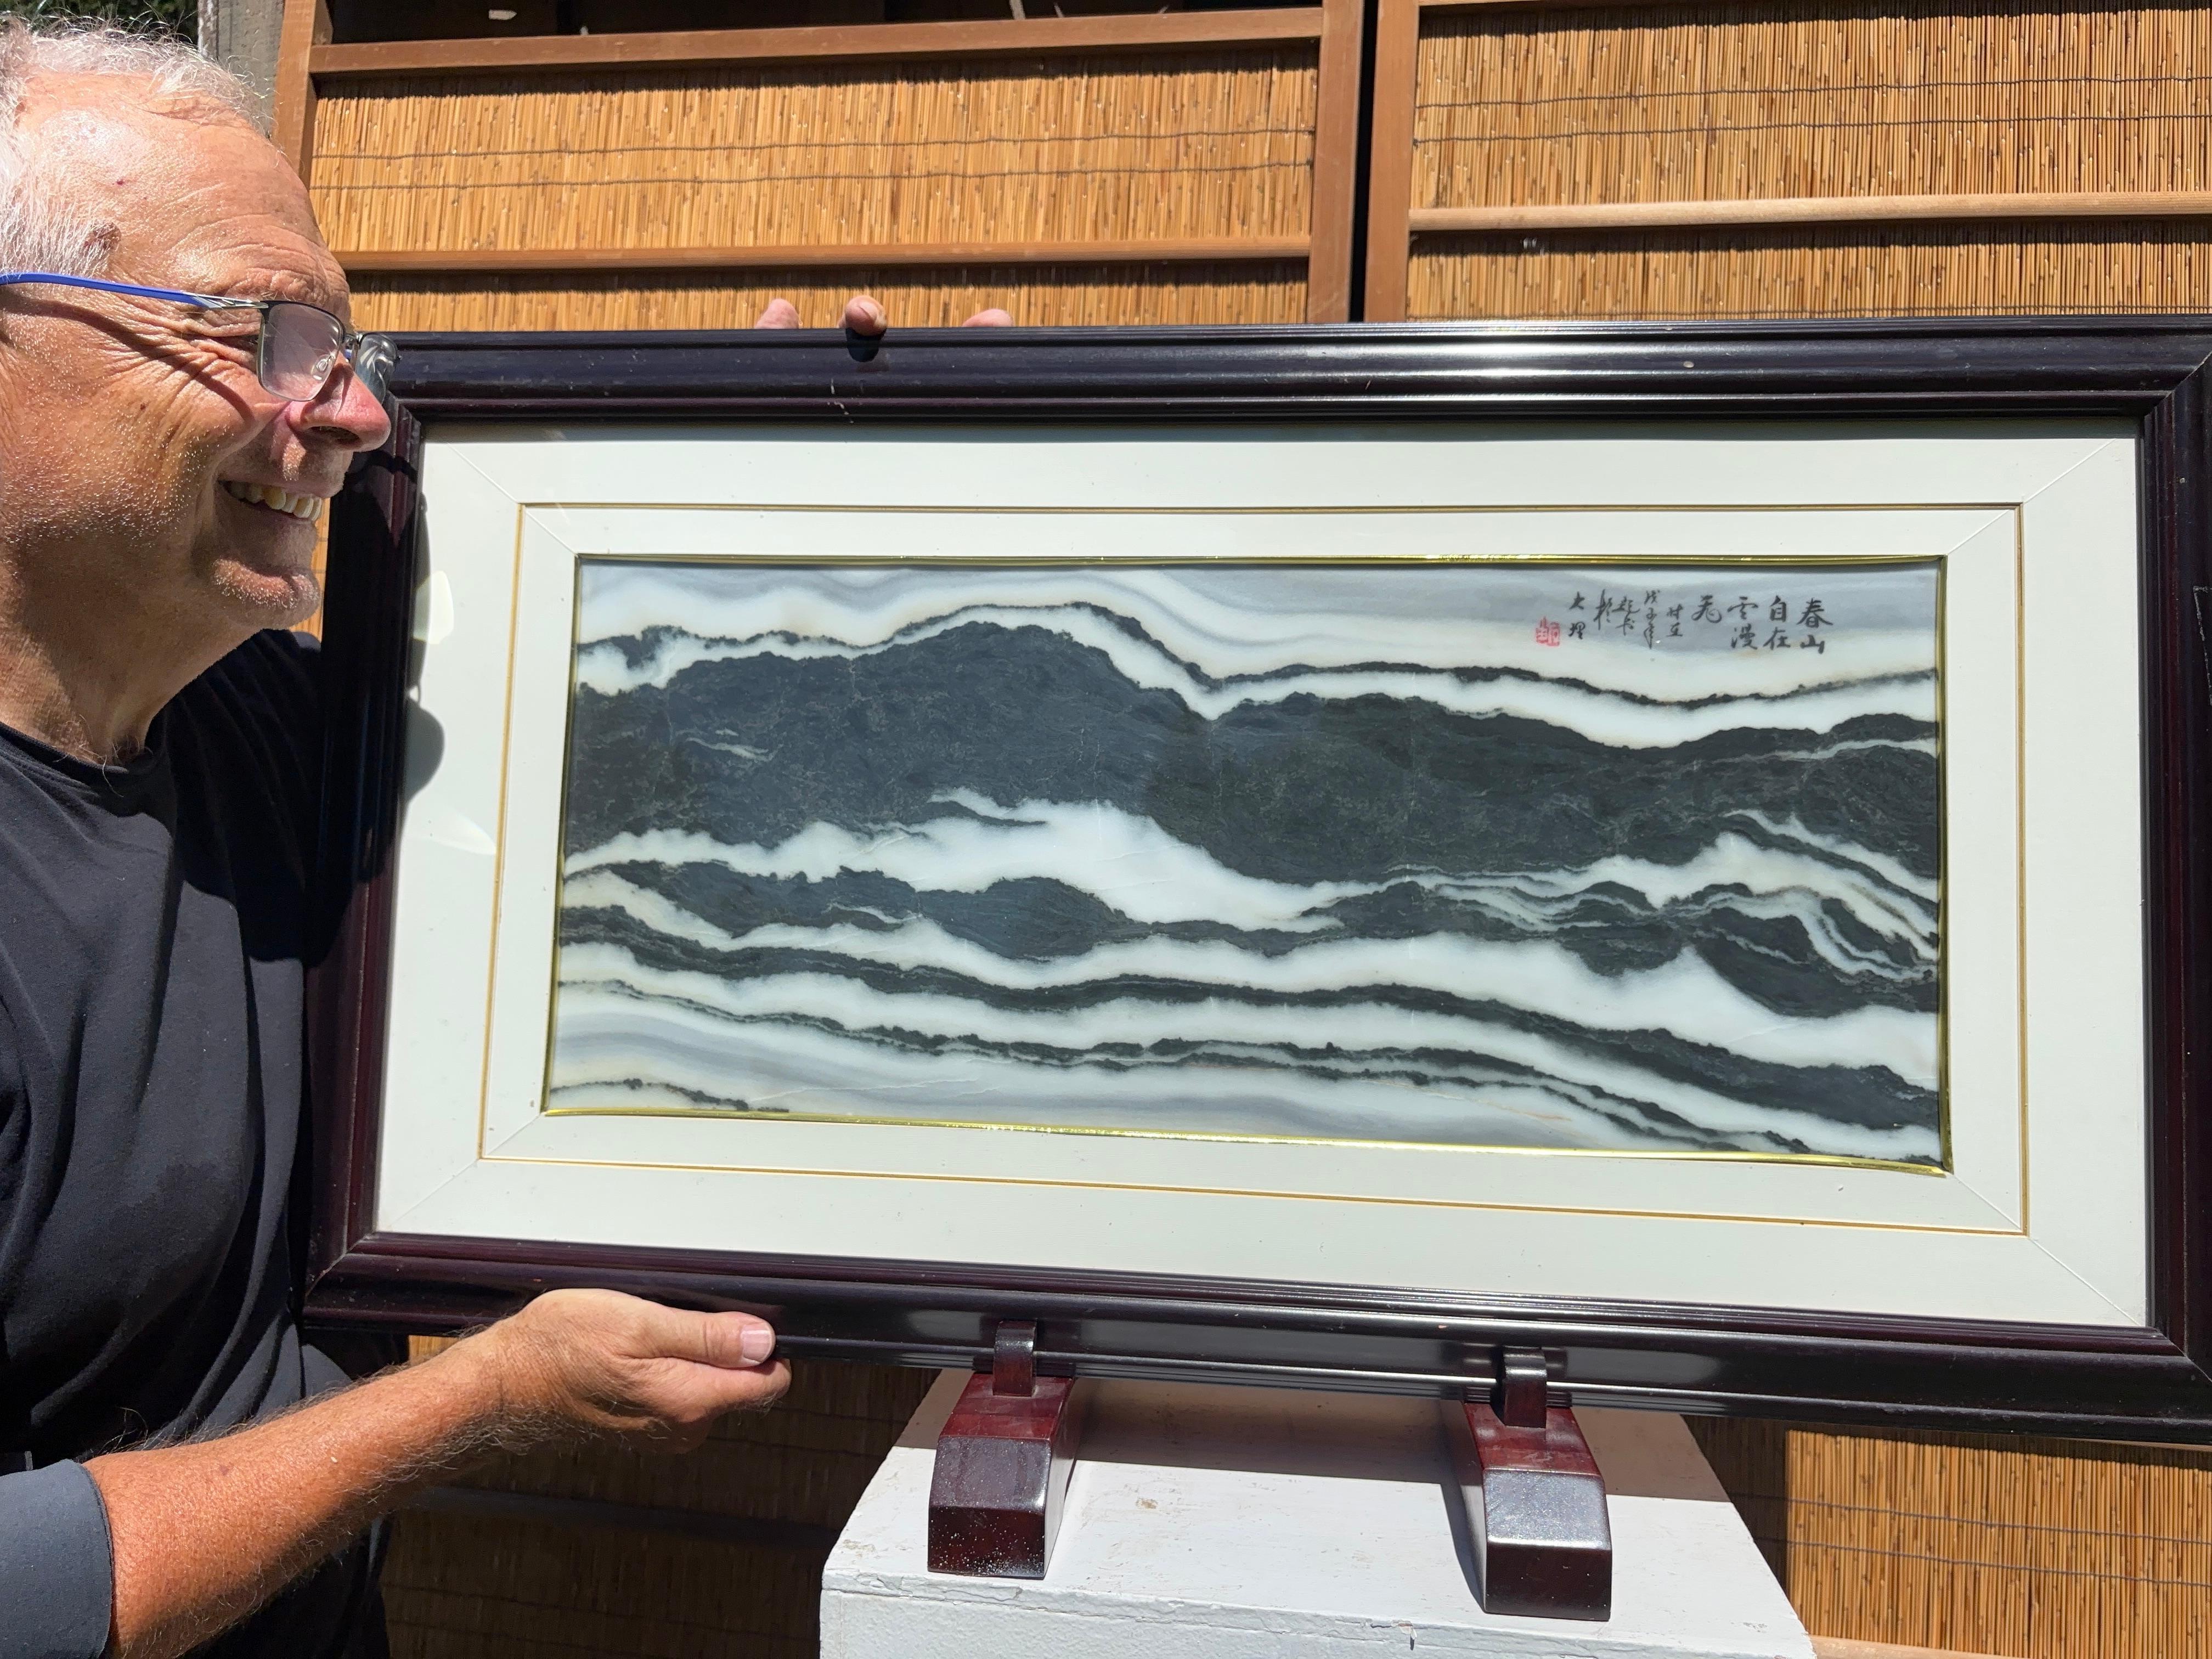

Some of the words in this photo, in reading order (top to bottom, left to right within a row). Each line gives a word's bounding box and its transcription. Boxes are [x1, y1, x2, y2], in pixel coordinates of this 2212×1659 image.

[1568, 591, 1586, 640] 大理
[1763, 595, 1791, 649] 自在
[1797, 597, 1833, 653] 春山
